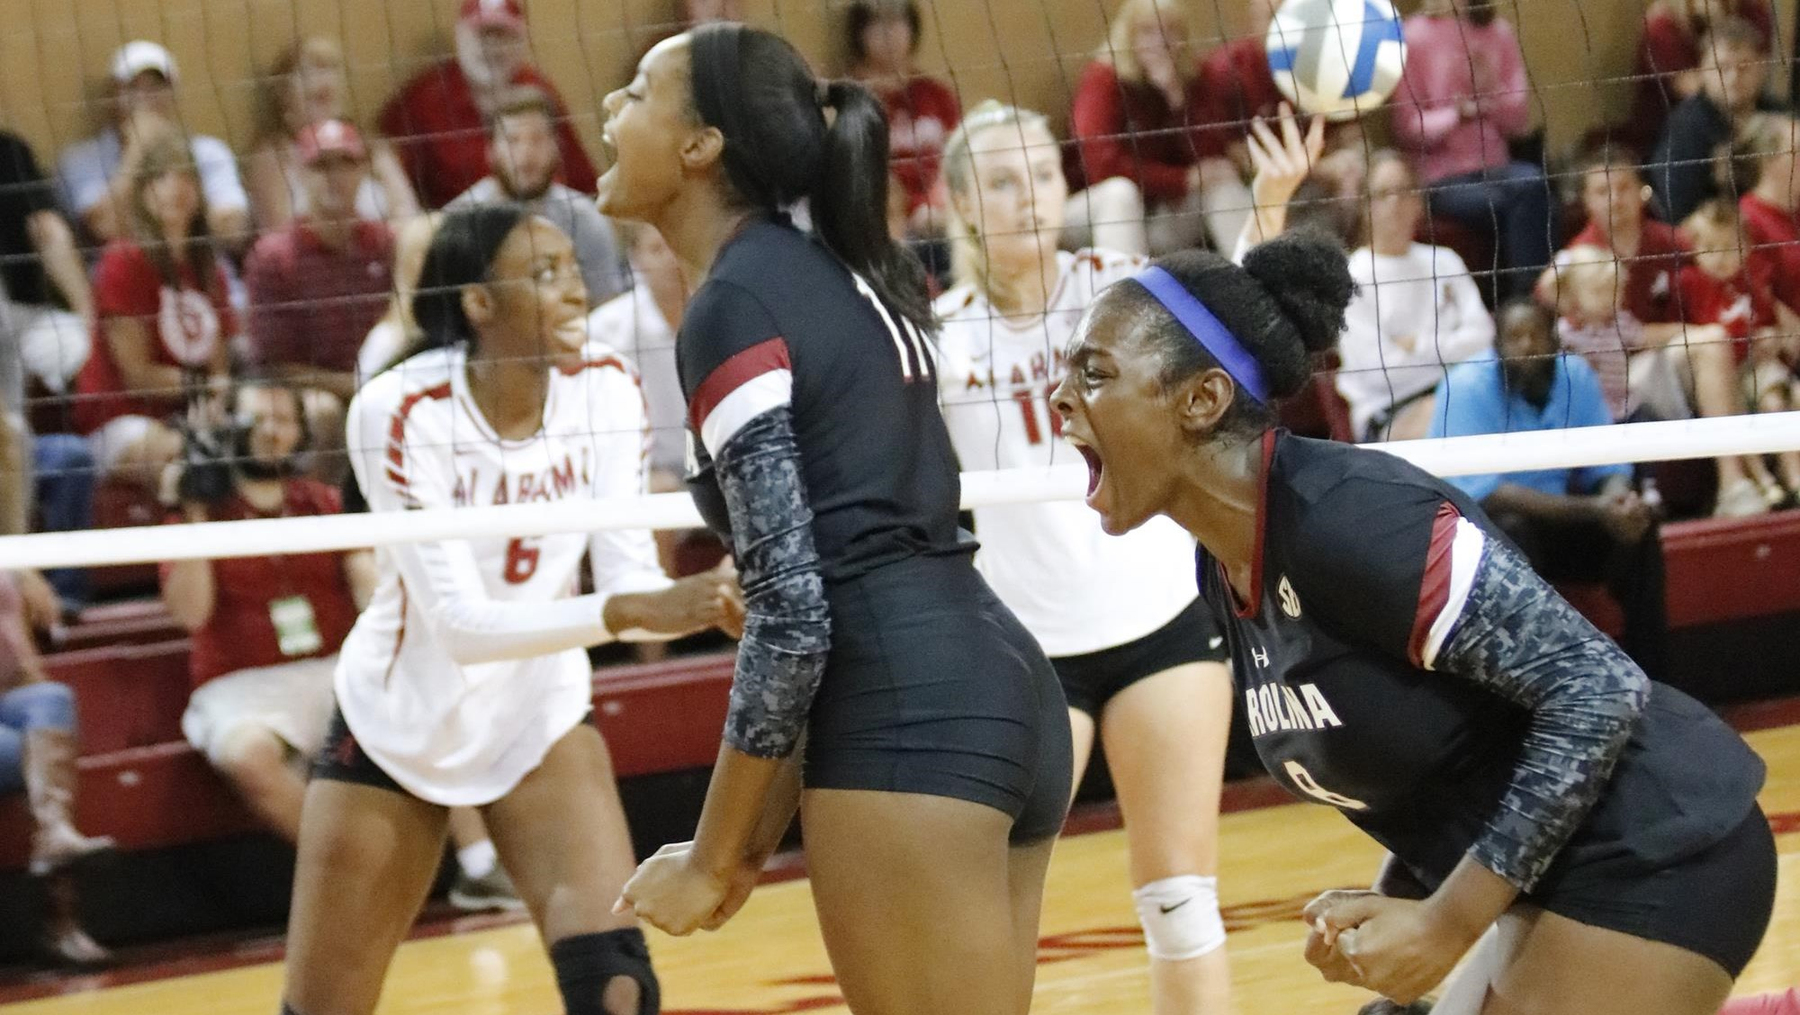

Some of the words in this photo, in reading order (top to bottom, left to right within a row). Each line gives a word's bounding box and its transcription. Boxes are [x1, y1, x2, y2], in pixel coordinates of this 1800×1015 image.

[503, 534, 541, 585] 6
[1245, 682, 1343, 738] ROLINA
[1283, 760, 1369, 811] 8
